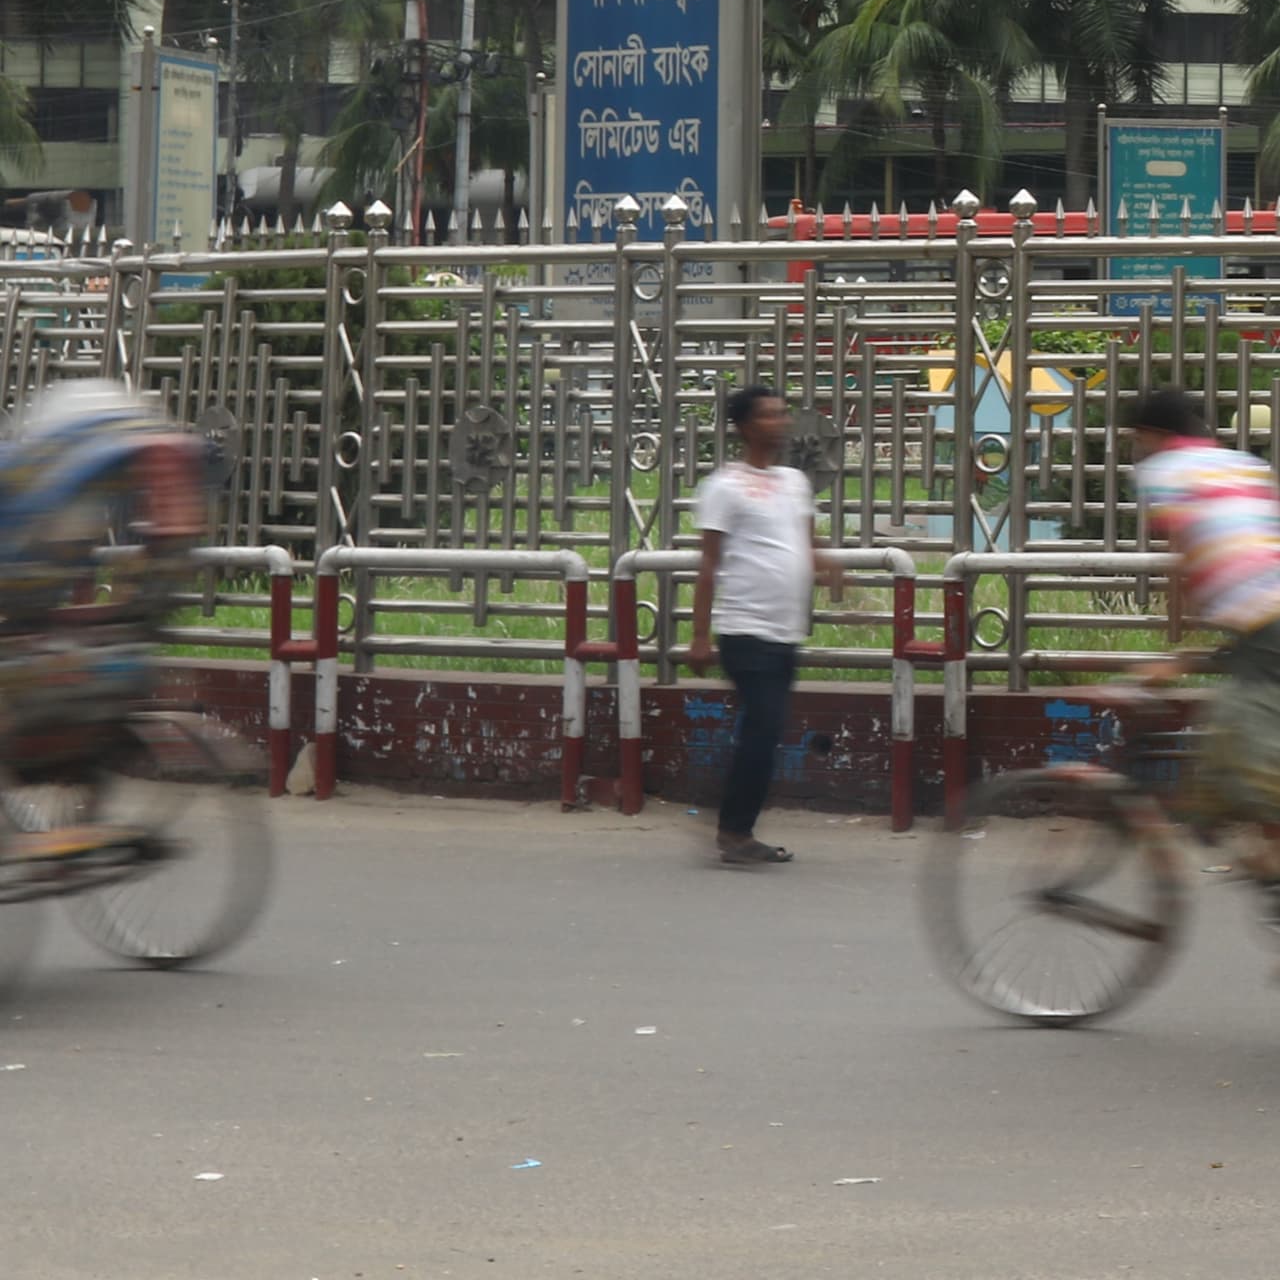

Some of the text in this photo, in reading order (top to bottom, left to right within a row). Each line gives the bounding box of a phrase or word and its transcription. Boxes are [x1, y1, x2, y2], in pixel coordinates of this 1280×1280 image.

[574, 33, 710, 88] সোনালী ব্যাংক
[578, 107, 702, 159] লিমিটেড এর
